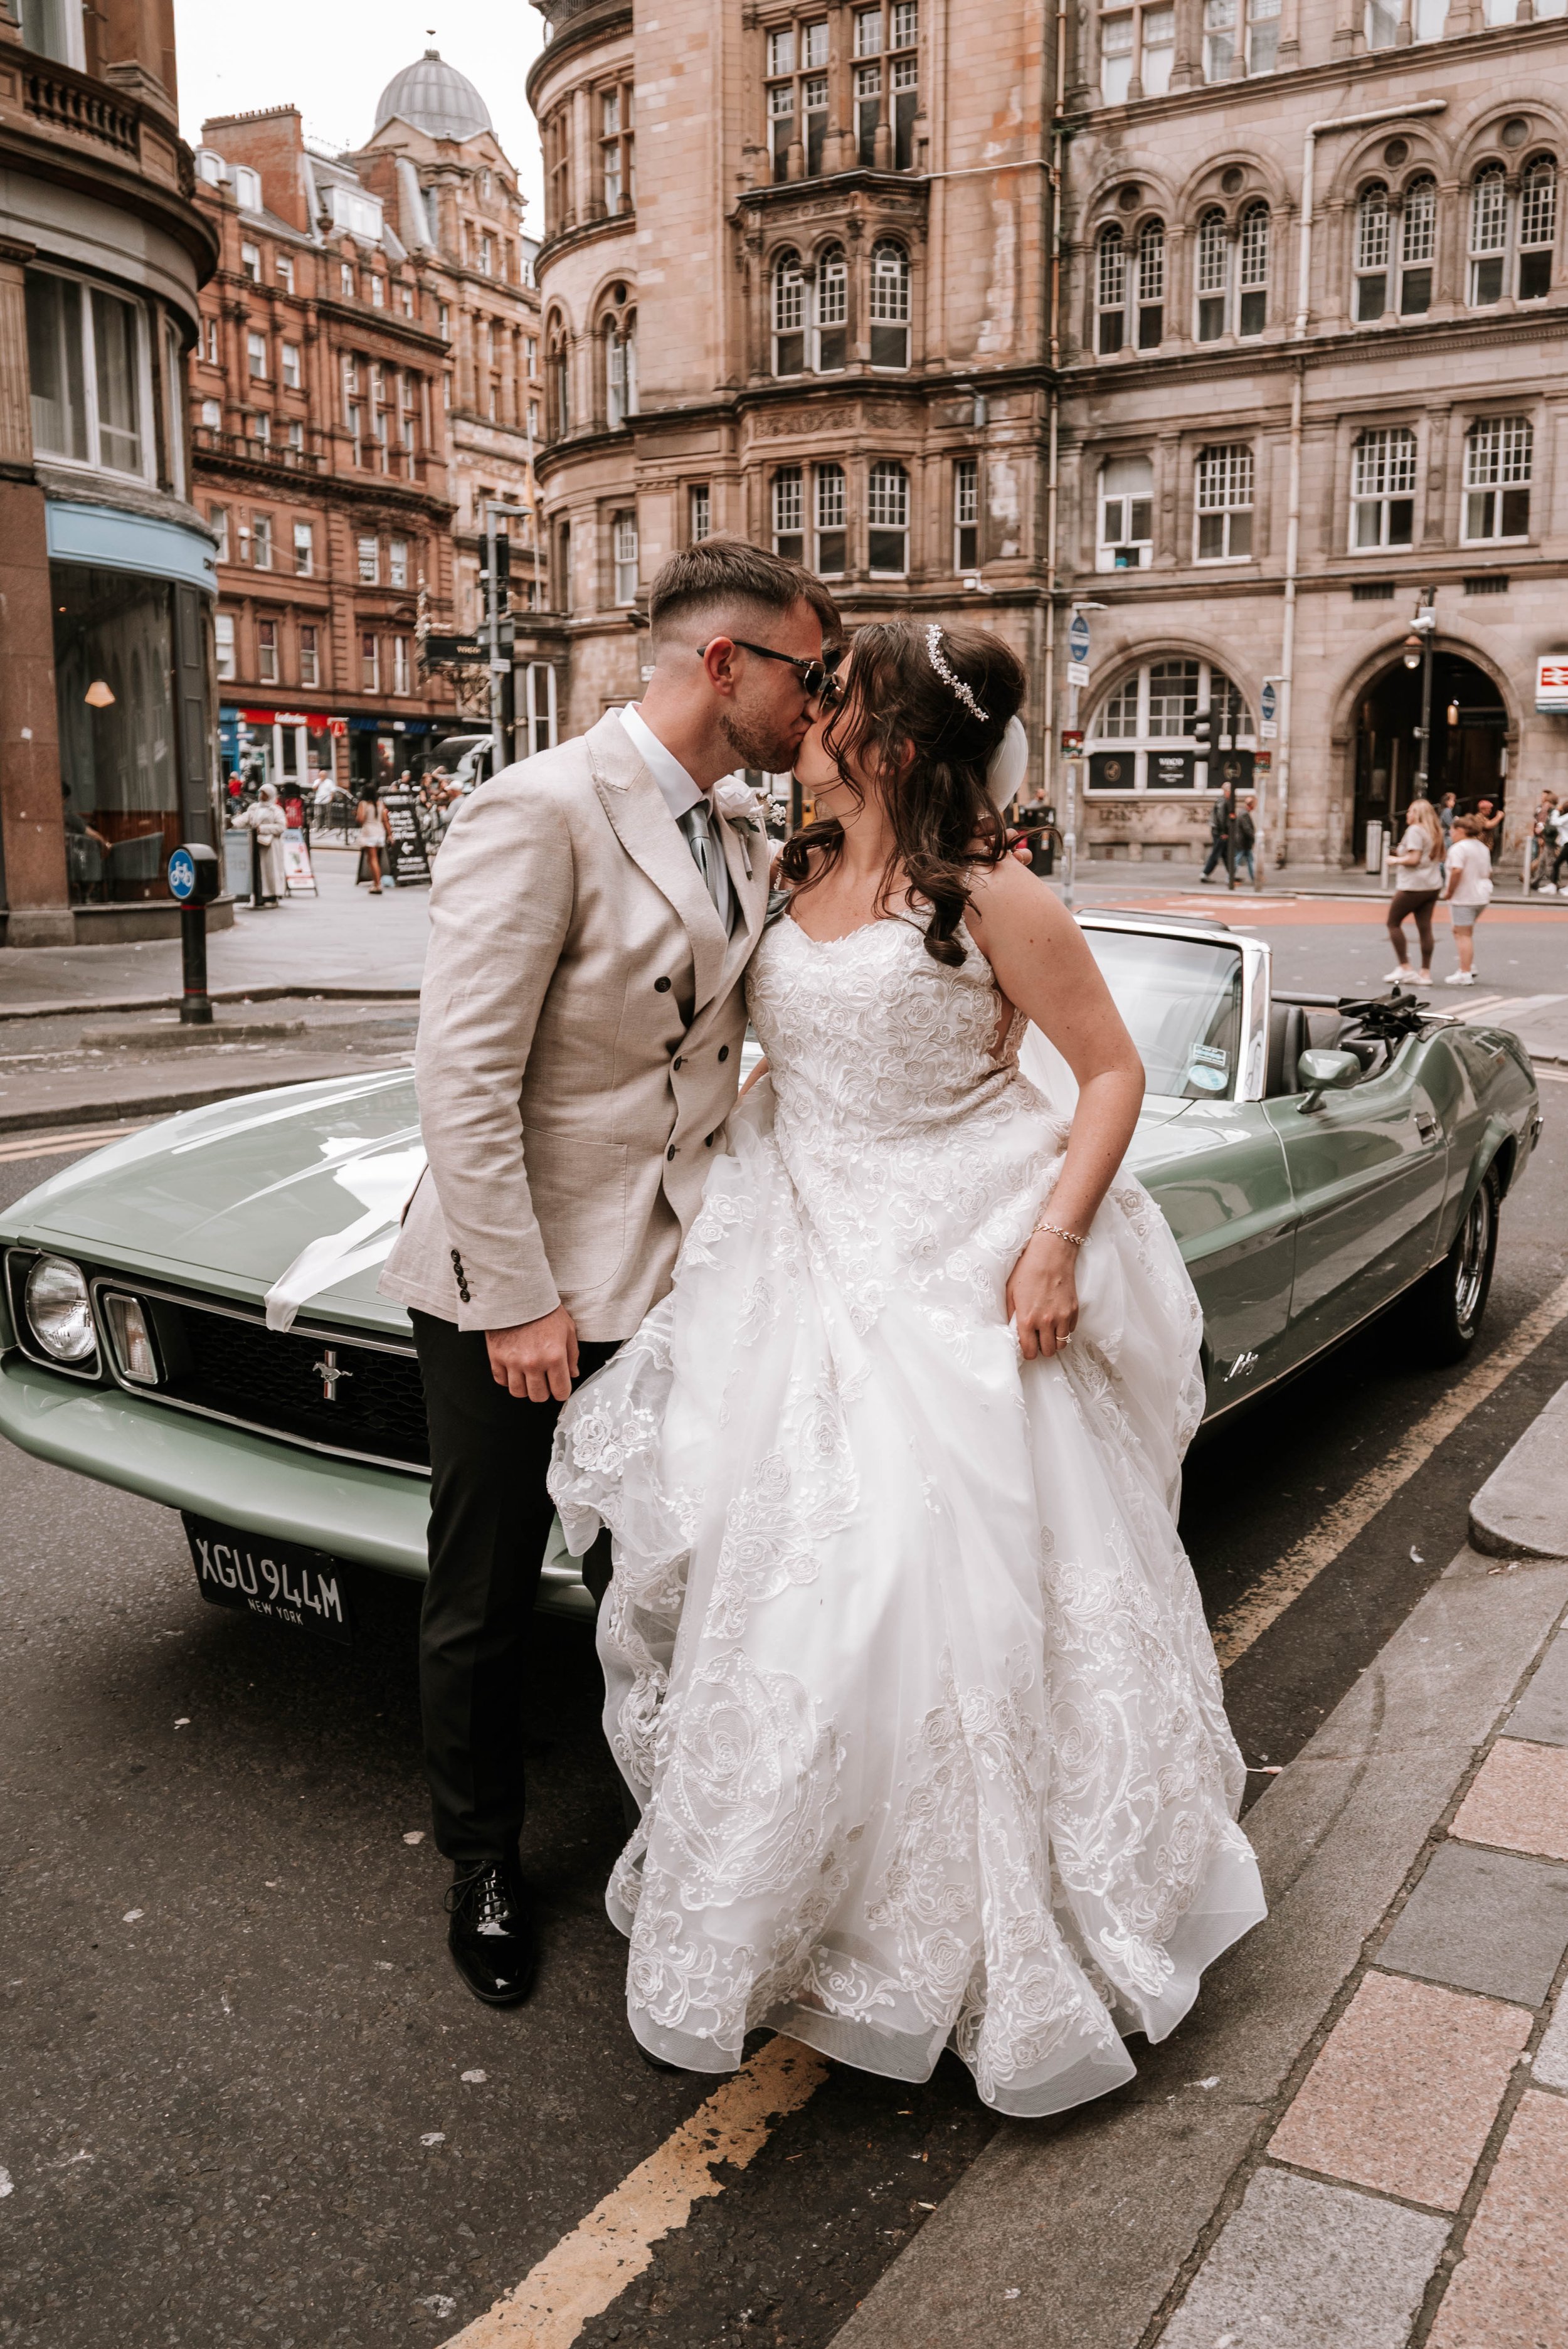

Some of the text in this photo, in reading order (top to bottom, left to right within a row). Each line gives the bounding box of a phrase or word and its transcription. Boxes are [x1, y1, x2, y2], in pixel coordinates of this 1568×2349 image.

[247, 1598, 304, 1626] NEW YORK
[260, 1559, 342, 1622] 944M
